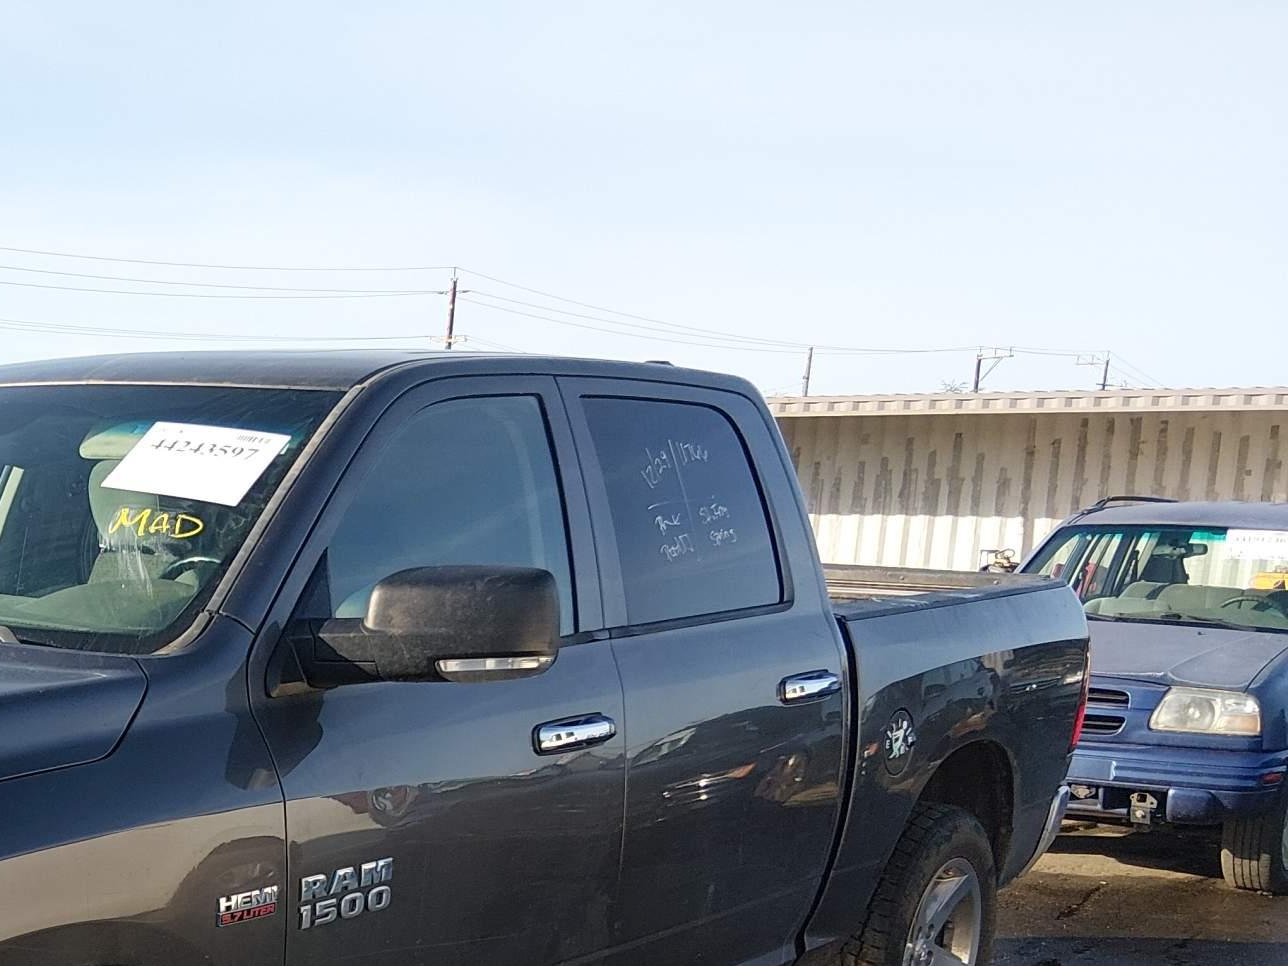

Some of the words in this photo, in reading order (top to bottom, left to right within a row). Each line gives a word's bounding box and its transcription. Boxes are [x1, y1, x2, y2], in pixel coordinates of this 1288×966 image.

[108, 507, 204, 539] MAD
[299, 857, 394, 901] RAM
[218, 885, 279, 912] HEMI
[243, 904, 276, 920] LITER
[299, 885, 392, 930] 1500
